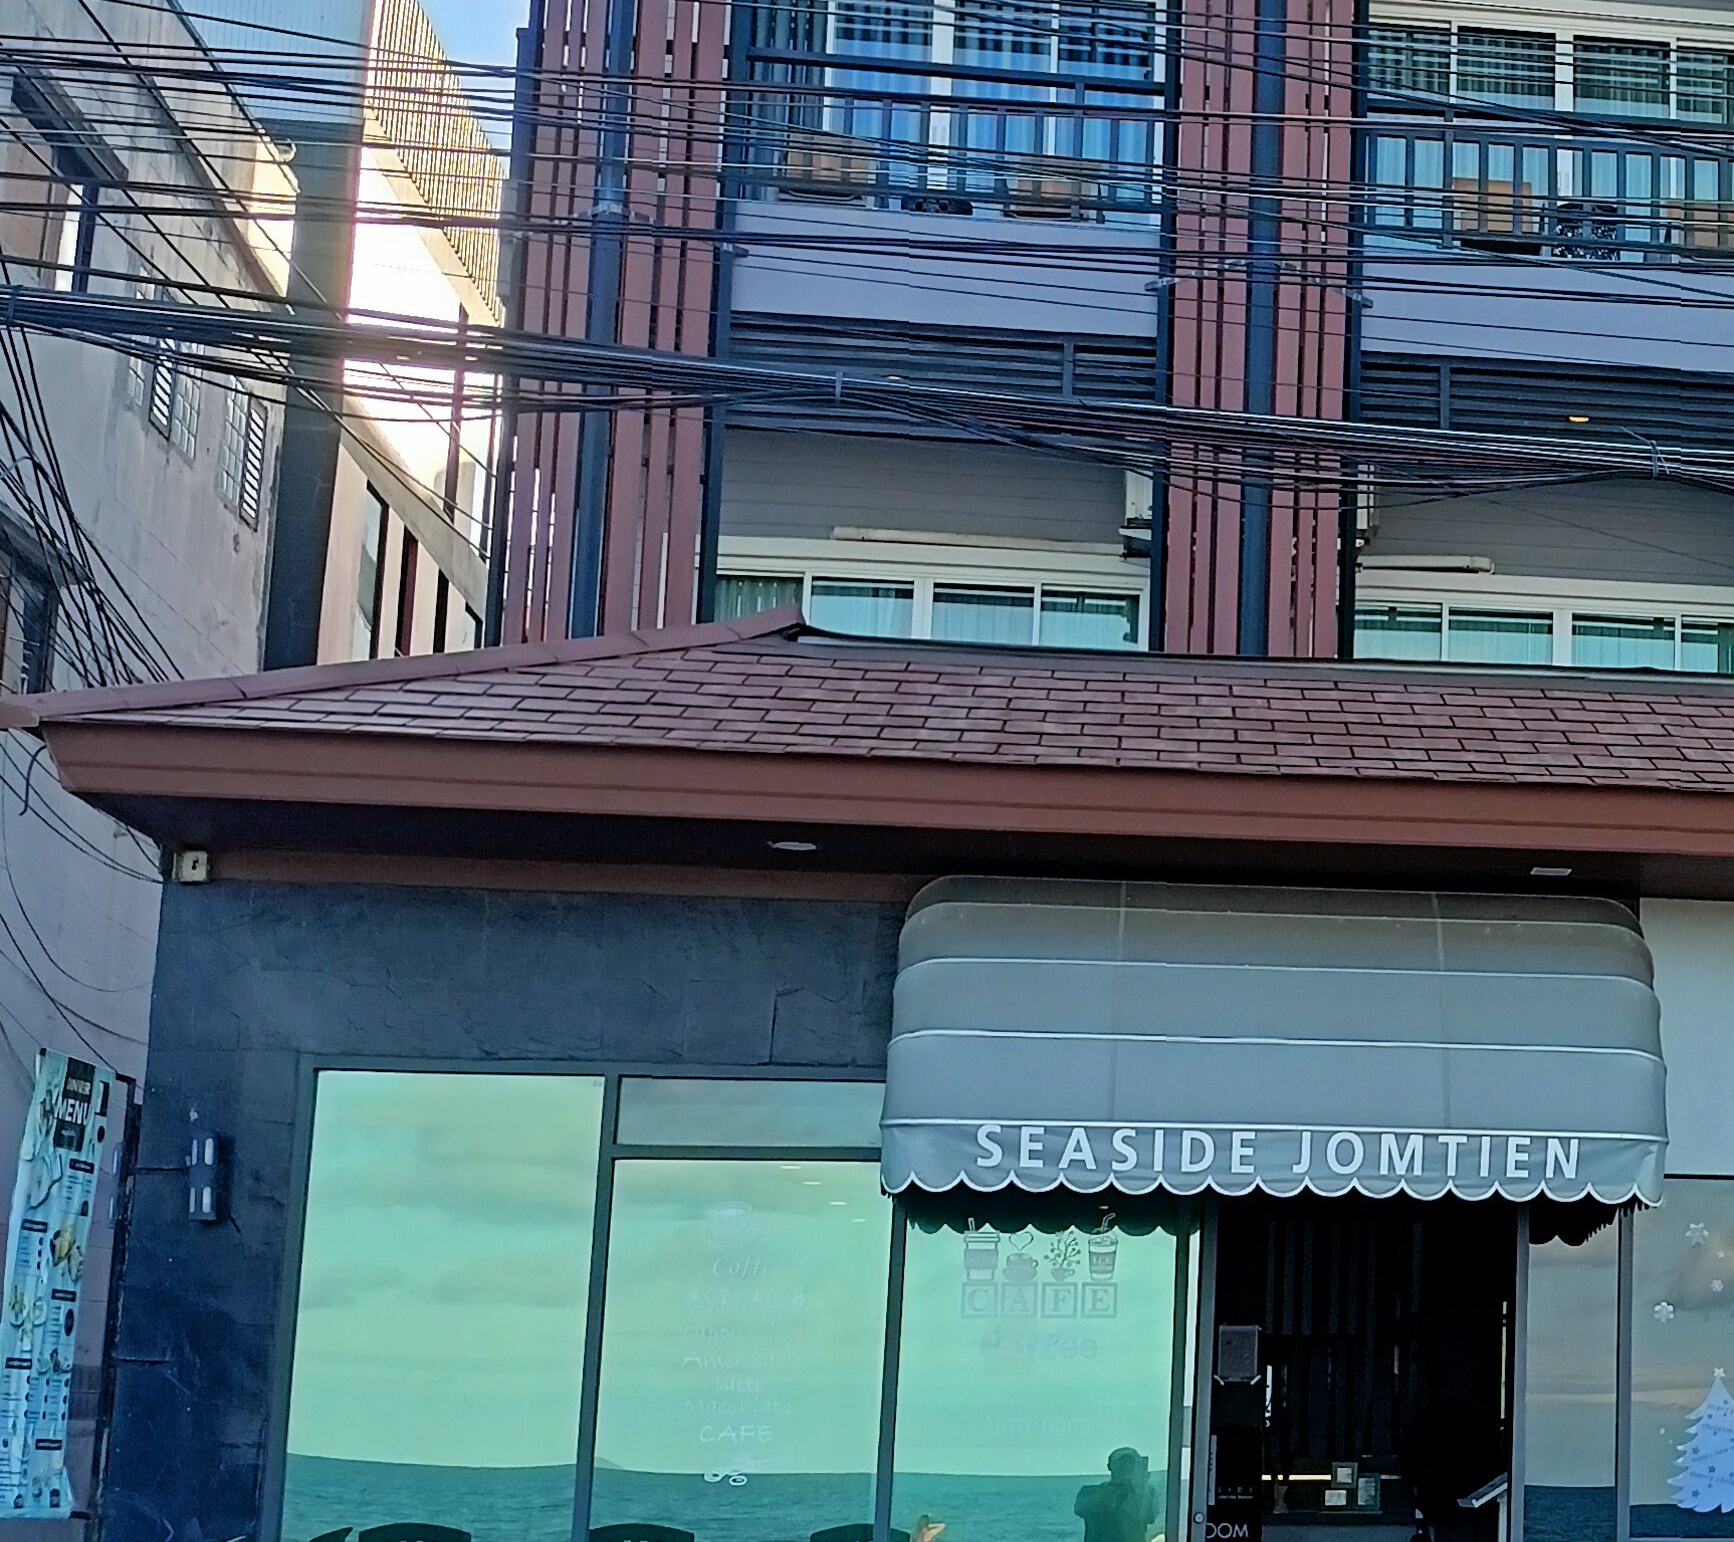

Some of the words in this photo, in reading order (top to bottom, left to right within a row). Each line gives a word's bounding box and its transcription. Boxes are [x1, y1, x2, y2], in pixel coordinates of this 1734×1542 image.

[54, 1095, 94, 1126] MENU
[975, 1124, 1256, 1173] SEASIDE
[1293, 1131, 1580, 1179] JOMTIEN
[966, 1288, 1111, 1313] CAFE
[700, 1425, 773, 1443] CAFE
